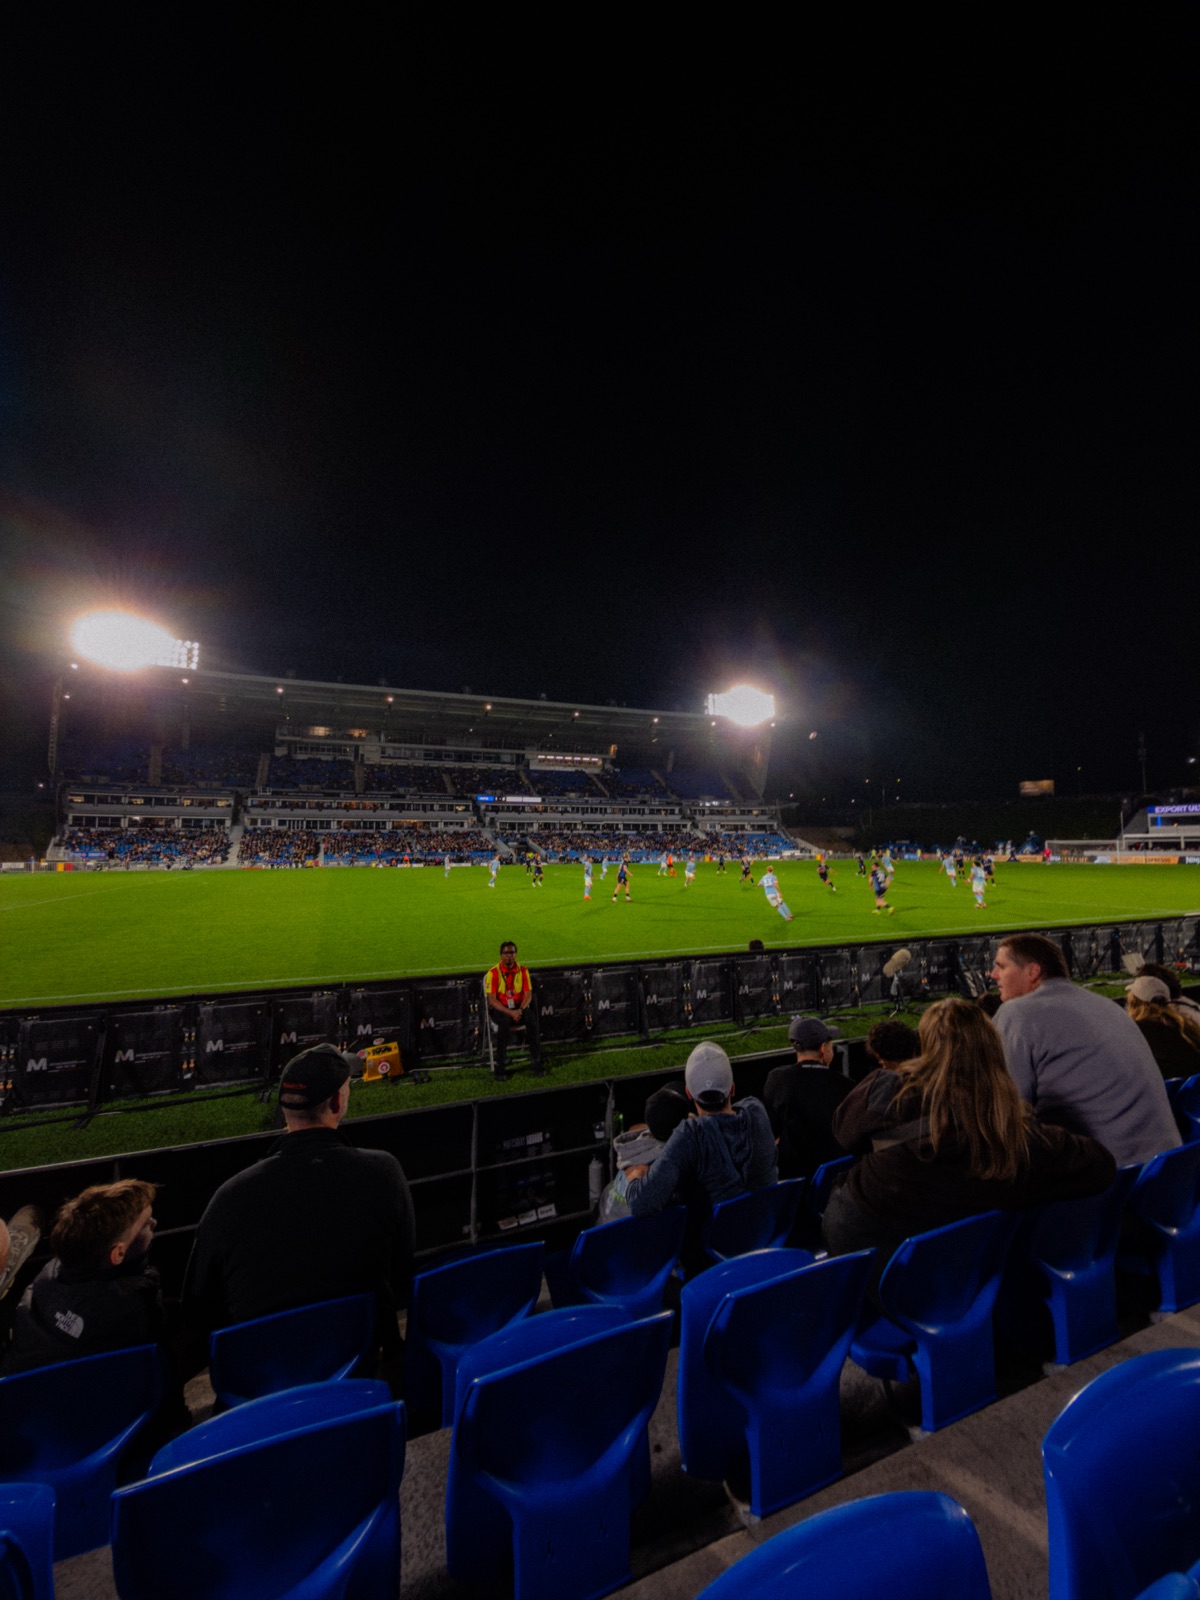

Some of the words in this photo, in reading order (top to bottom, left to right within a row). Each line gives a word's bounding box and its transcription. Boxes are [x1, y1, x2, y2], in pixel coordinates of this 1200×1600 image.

[1155, 805, 1187, 813] EXPORT
[783, 981, 793, 990] M
[822, 977, 831, 986] M
[696, 990, 707, 999] M
[739, 985, 749, 995] M
[647, 994, 657, 1004] M
[598, 1000, 610, 1010] M
[541, 1005, 554, 1016] M
[420, 1017, 435, 1029] M
[357, 1024, 372, 1036] M
[280, 1031, 298, 1045] M
[206, 1039, 224, 1052] M
[115, 1049, 135, 1062] M
[26, 1058, 48, 1072] M
